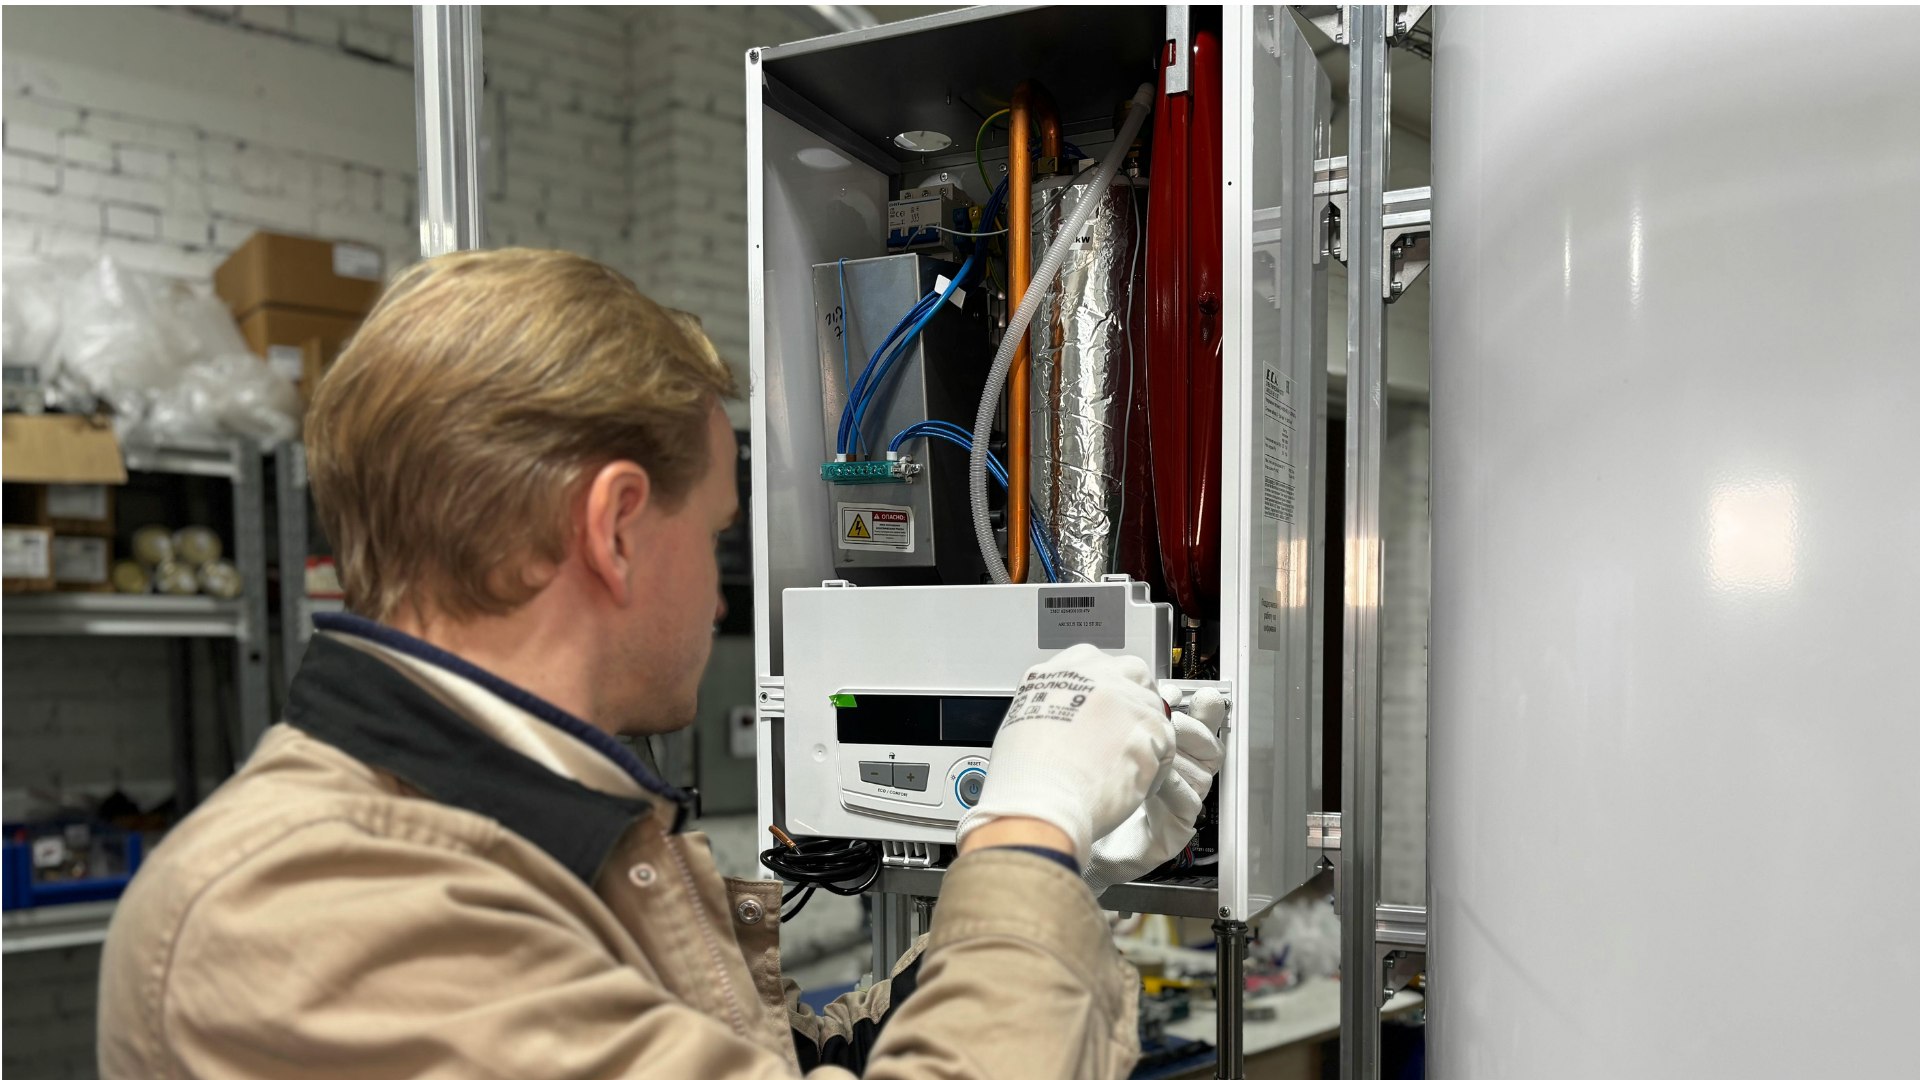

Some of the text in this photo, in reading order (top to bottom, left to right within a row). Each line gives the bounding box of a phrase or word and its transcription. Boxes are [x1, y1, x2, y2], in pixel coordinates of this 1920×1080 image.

[881, 513, 907, 521] ОПАСНО:
[1026, 670, 1095, 683] БАНТИНГ
[1018, 681, 1096, 695] ЭВОЛЮШН
[1069, 694, 1087, 708] 9
